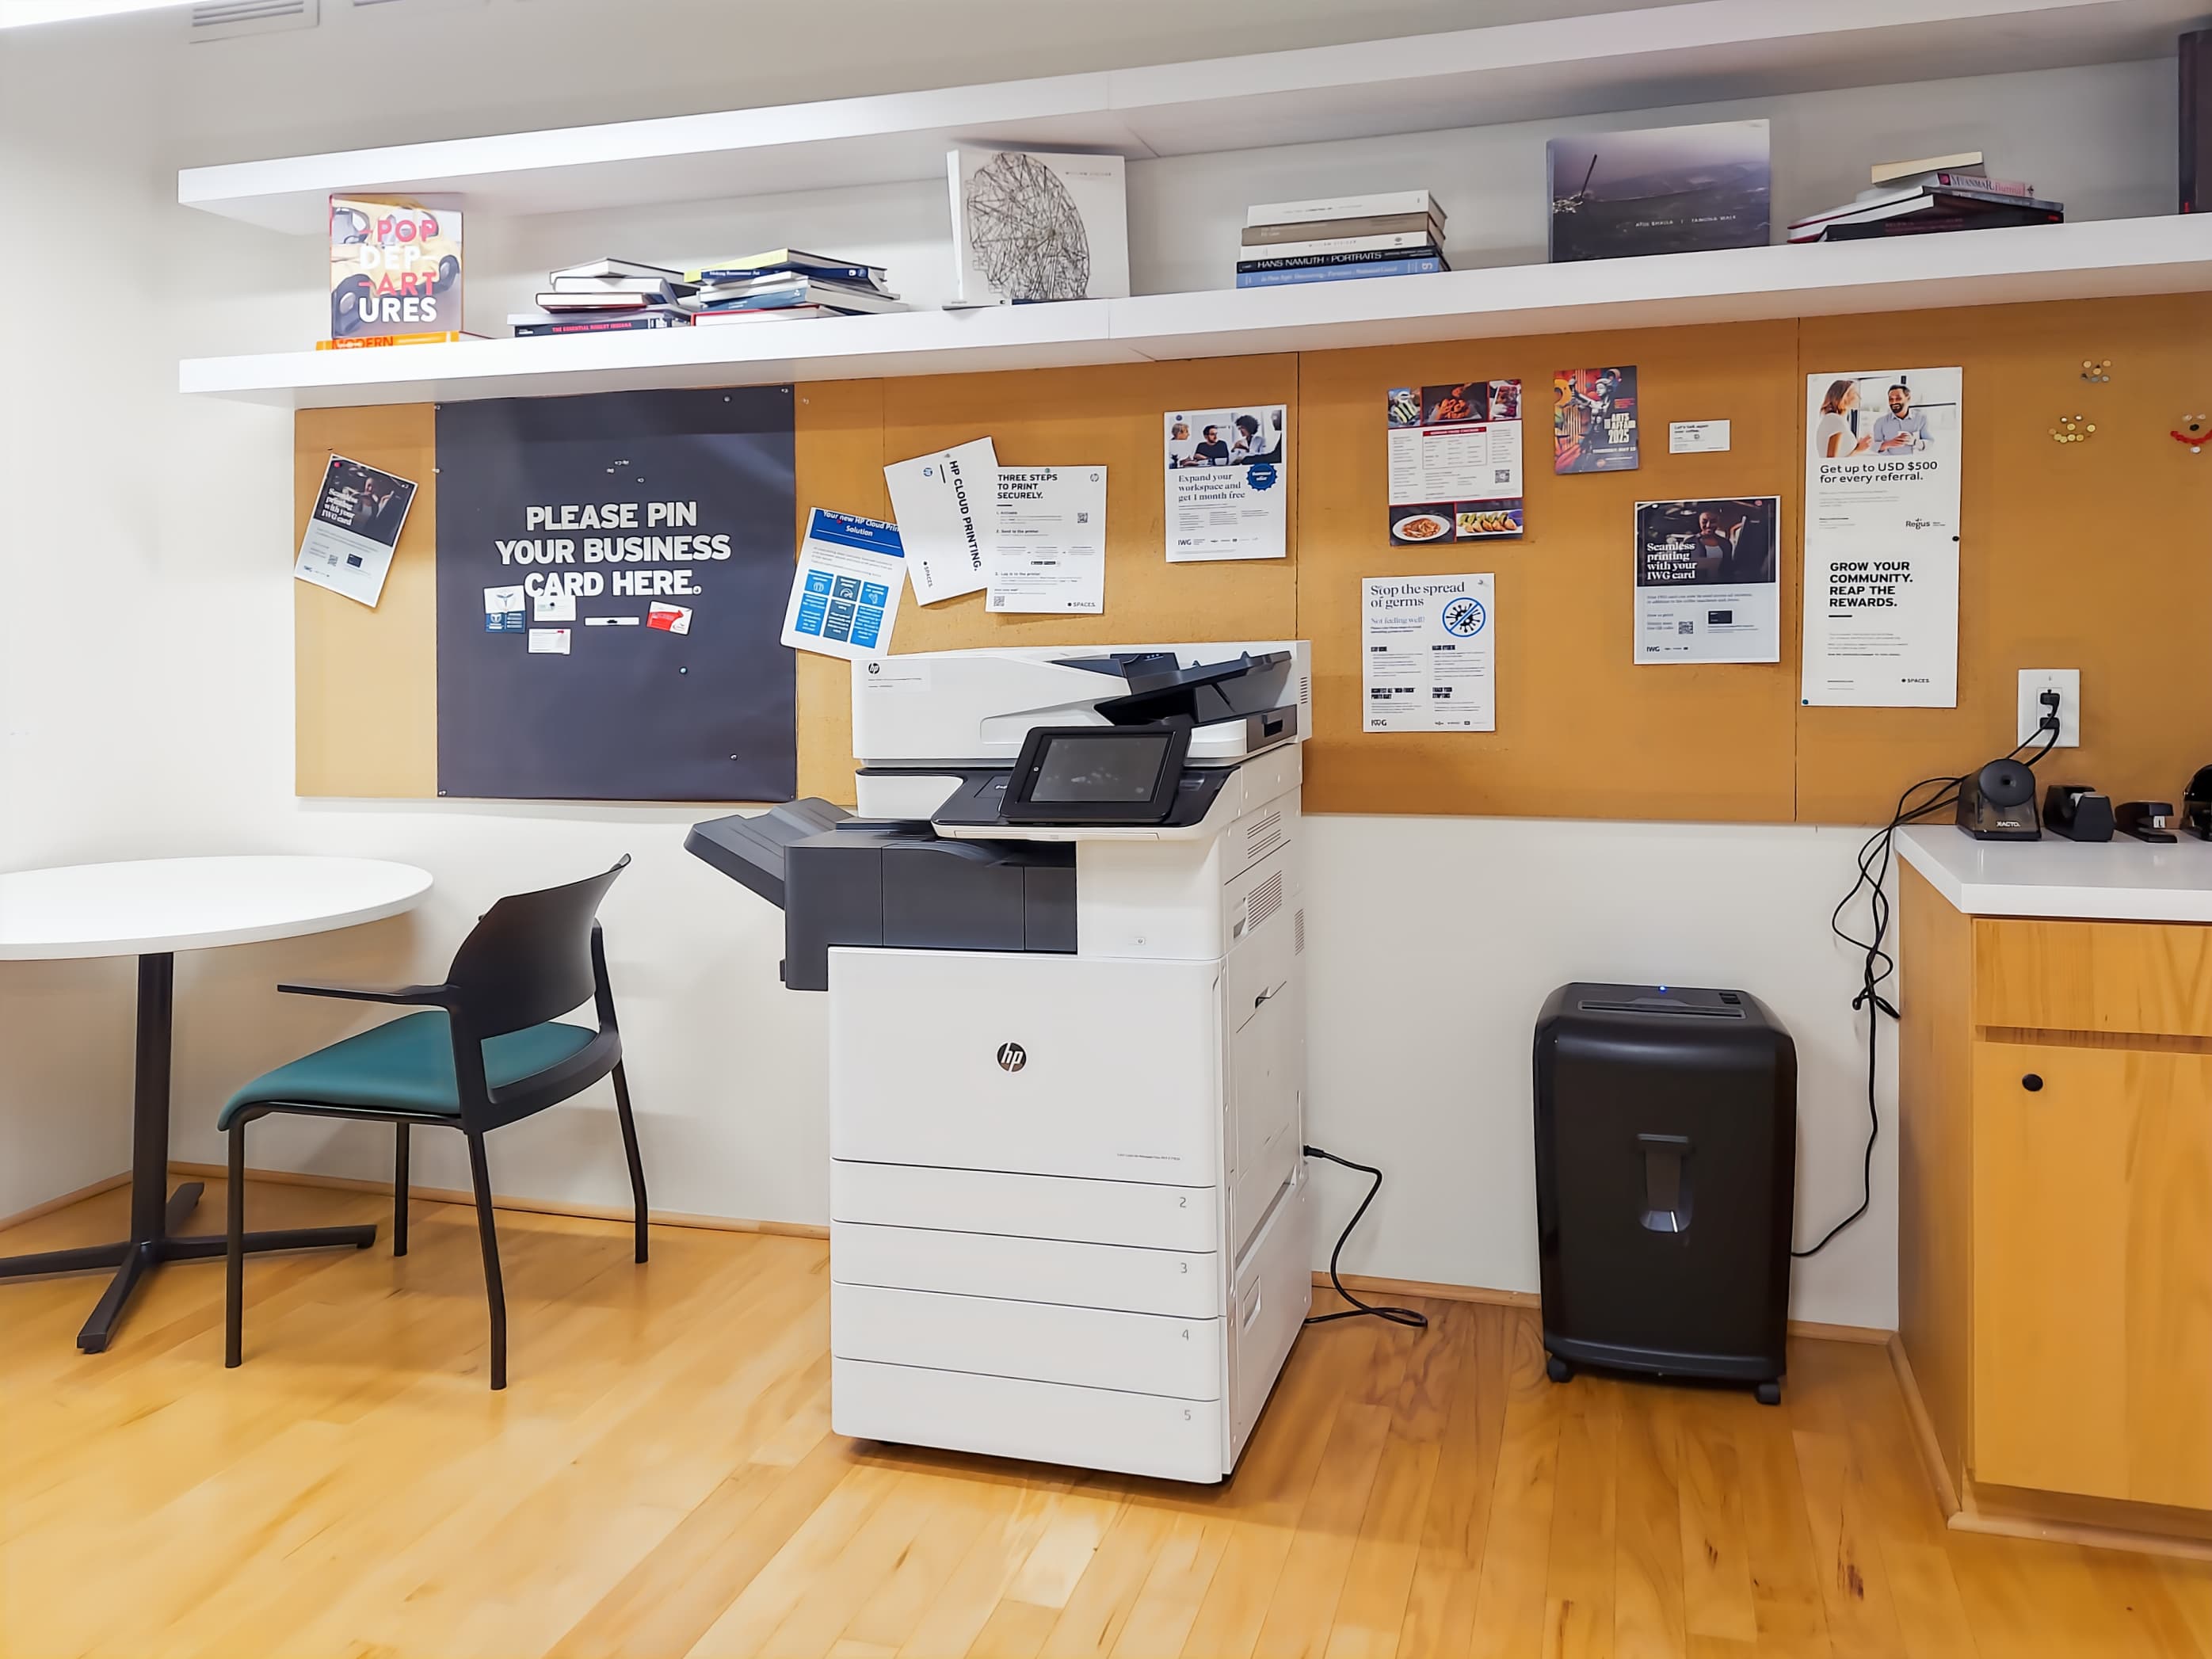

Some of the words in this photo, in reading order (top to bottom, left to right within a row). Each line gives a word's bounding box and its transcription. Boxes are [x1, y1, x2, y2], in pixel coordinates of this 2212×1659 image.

[1257, 259, 1283, 269] HANS
[1285, 256, 1325, 267] NAMUTH
[1331, 251, 1382, 265] PORTRAITS
[358, 297, 437, 323] URES
[1608, 429, 1630, 444] 2025
[949, 460, 961, 476] HP
[1821, 464, 1841, 474] Get
[1845, 466, 1859, 475] up
[1878, 462, 1905, 471] USD
[1908, 461, 1938, 471] $500
[1178, 473, 1211, 483] Expand
[1213, 474, 1233, 484] your
[1820, 475, 1836, 483] for
[1840, 475, 1872, 485] every
[1875, 471, 1924, 482] referral.
[1178, 482, 1224, 493] workspace
[1224, 481, 1241, 490] and
[954, 478, 970, 516] CLOUD
[1178, 494, 1192, 503] get
[1199, 490, 1227, 500] month
[1229, 490, 1246, 499] free
[526, 502, 639, 531] PLEASE
[647, 501, 697, 528] PIN
[823, 509, 840, 521] Your
[839, 515, 854, 524] new
[865, 519, 885, 530] Cloud
[886, 521, 900, 532] Prin
[845, 524, 873, 537] Solution
[1905, 520, 1931, 530] Regus
[495, 538, 576, 565] YOUR
[583, 534, 732, 563] BUSINESS
[963, 517, 982, 572] PRINTING.
[1647, 541, 1695, 551] Seamless
[1647, 551, 1691, 563] printing
[1647, 561, 1671, 570] with
[1672, 562, 1698, 571] your
[1830, 563, 1869, 571] GROW
[1874, 562, 1910, 570] YOUR
[1647, 571, 1671, 580] IWG
[1672, 570, 1695, 579] card
[1829, 574, 1913, 584] COMMUNITY.
[524, 570, 604, 597] CARD
[612, 569, 702, 597] HERE.
[1371, 585, 1399, 597] Stop
[1402, 584, 1421, 594] the
[1423, 582, 1465, 596] spread
[1829, 586, 1865, 595] REAP
[1869, 586, 1896, 595] THE
[1371, 596, 1384, 608] of
[1385, 598, 1424, 610] germs
[1829, 597, 1897, 607] REWARDS.
[996, 1042, 1027, 1072] hp
[1179, 1197, 1187, 1208] 2
[1180, 1263, 1188, 1274] 3
[1182, 1329, 1189, 1341] 4
[1184, 1410, 1192, 1421] 5
